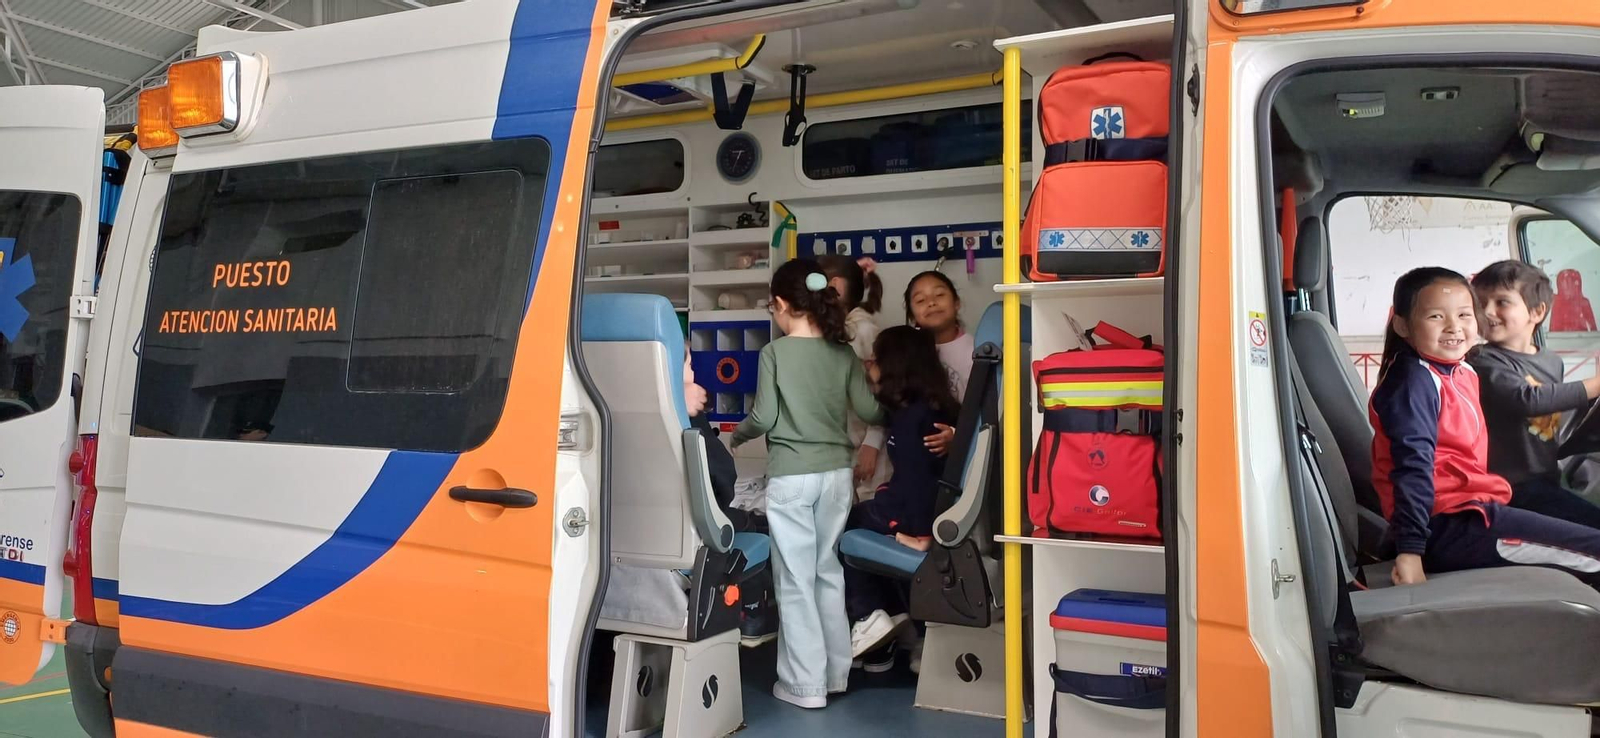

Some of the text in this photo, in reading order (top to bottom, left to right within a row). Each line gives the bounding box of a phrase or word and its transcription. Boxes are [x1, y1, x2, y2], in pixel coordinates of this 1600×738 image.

[212, 260, 291, 288] PUESTO
[159, 307, 337, 333] ATENCION SANITARIA
